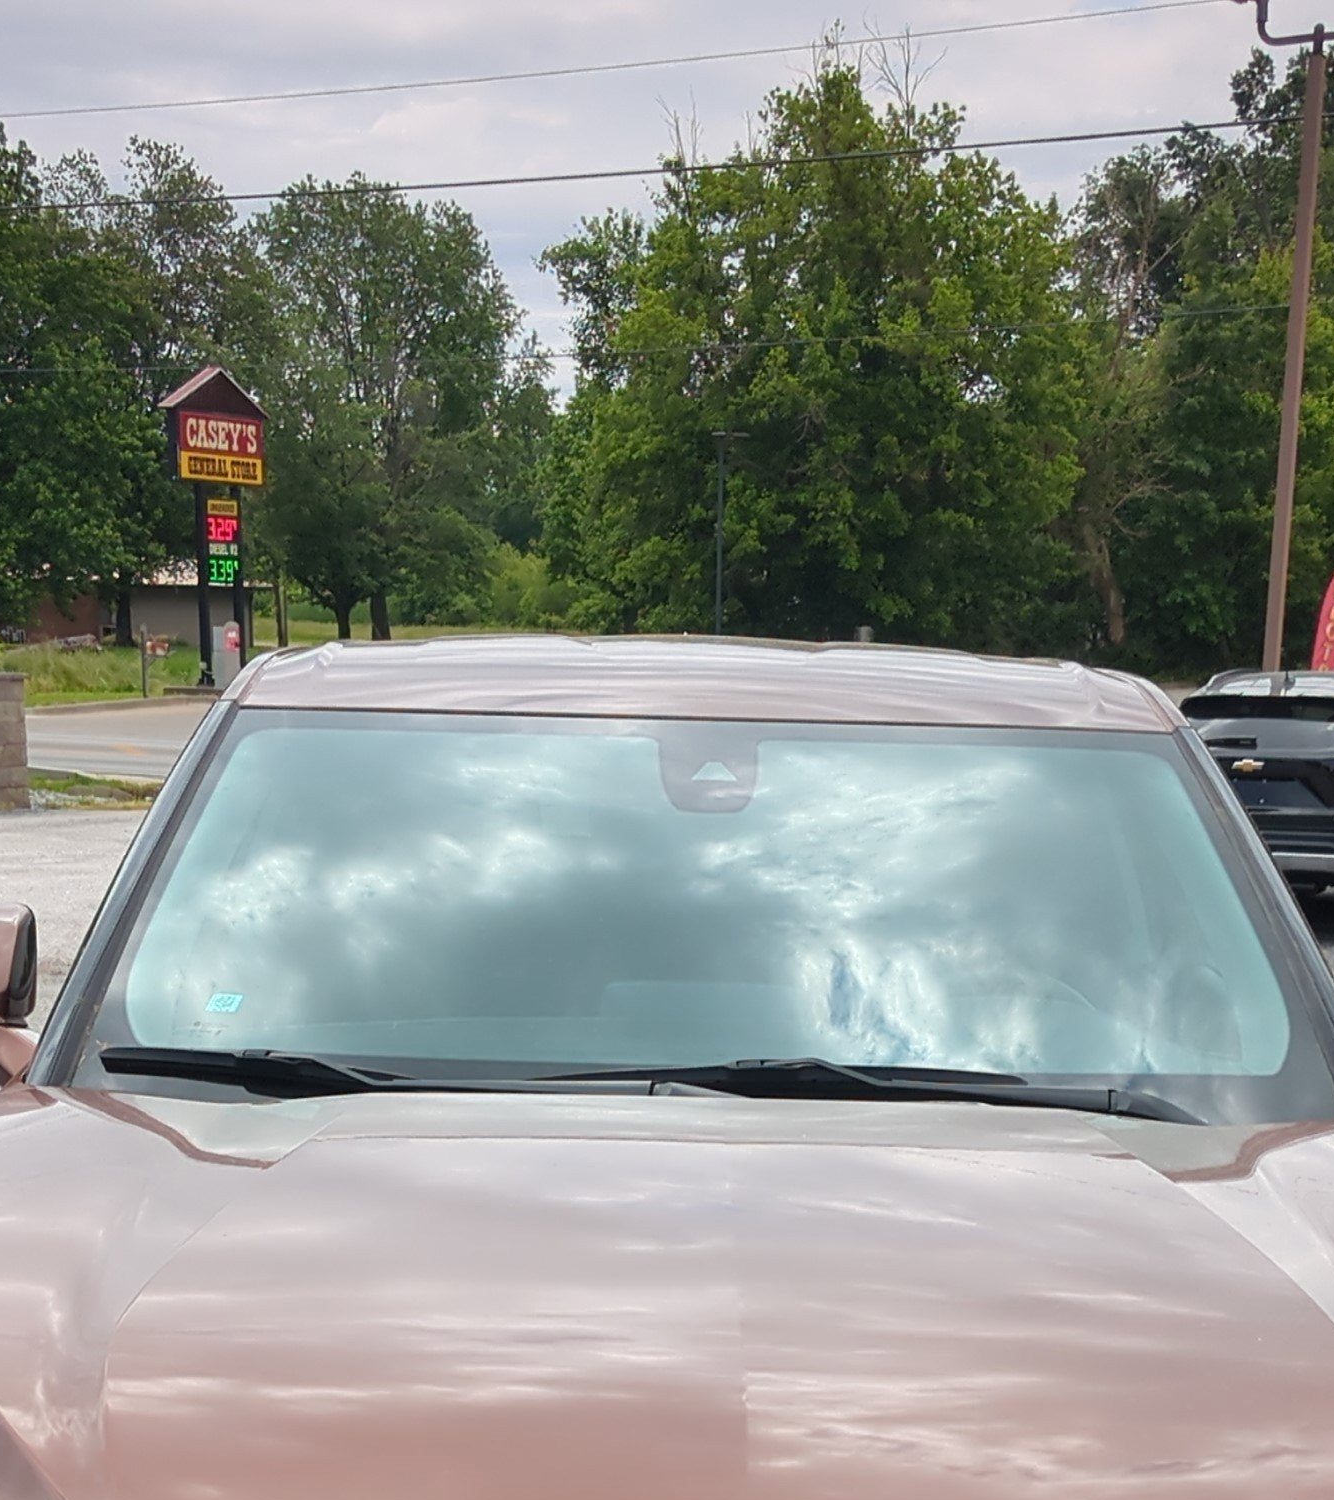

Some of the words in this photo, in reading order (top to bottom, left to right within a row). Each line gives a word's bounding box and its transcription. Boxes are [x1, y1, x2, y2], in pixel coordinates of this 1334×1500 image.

[186, 417, 258, 455] CASEY'S
[188, 456, 229, 478] GENERAL
[230, 460, 258, 481] STORE
